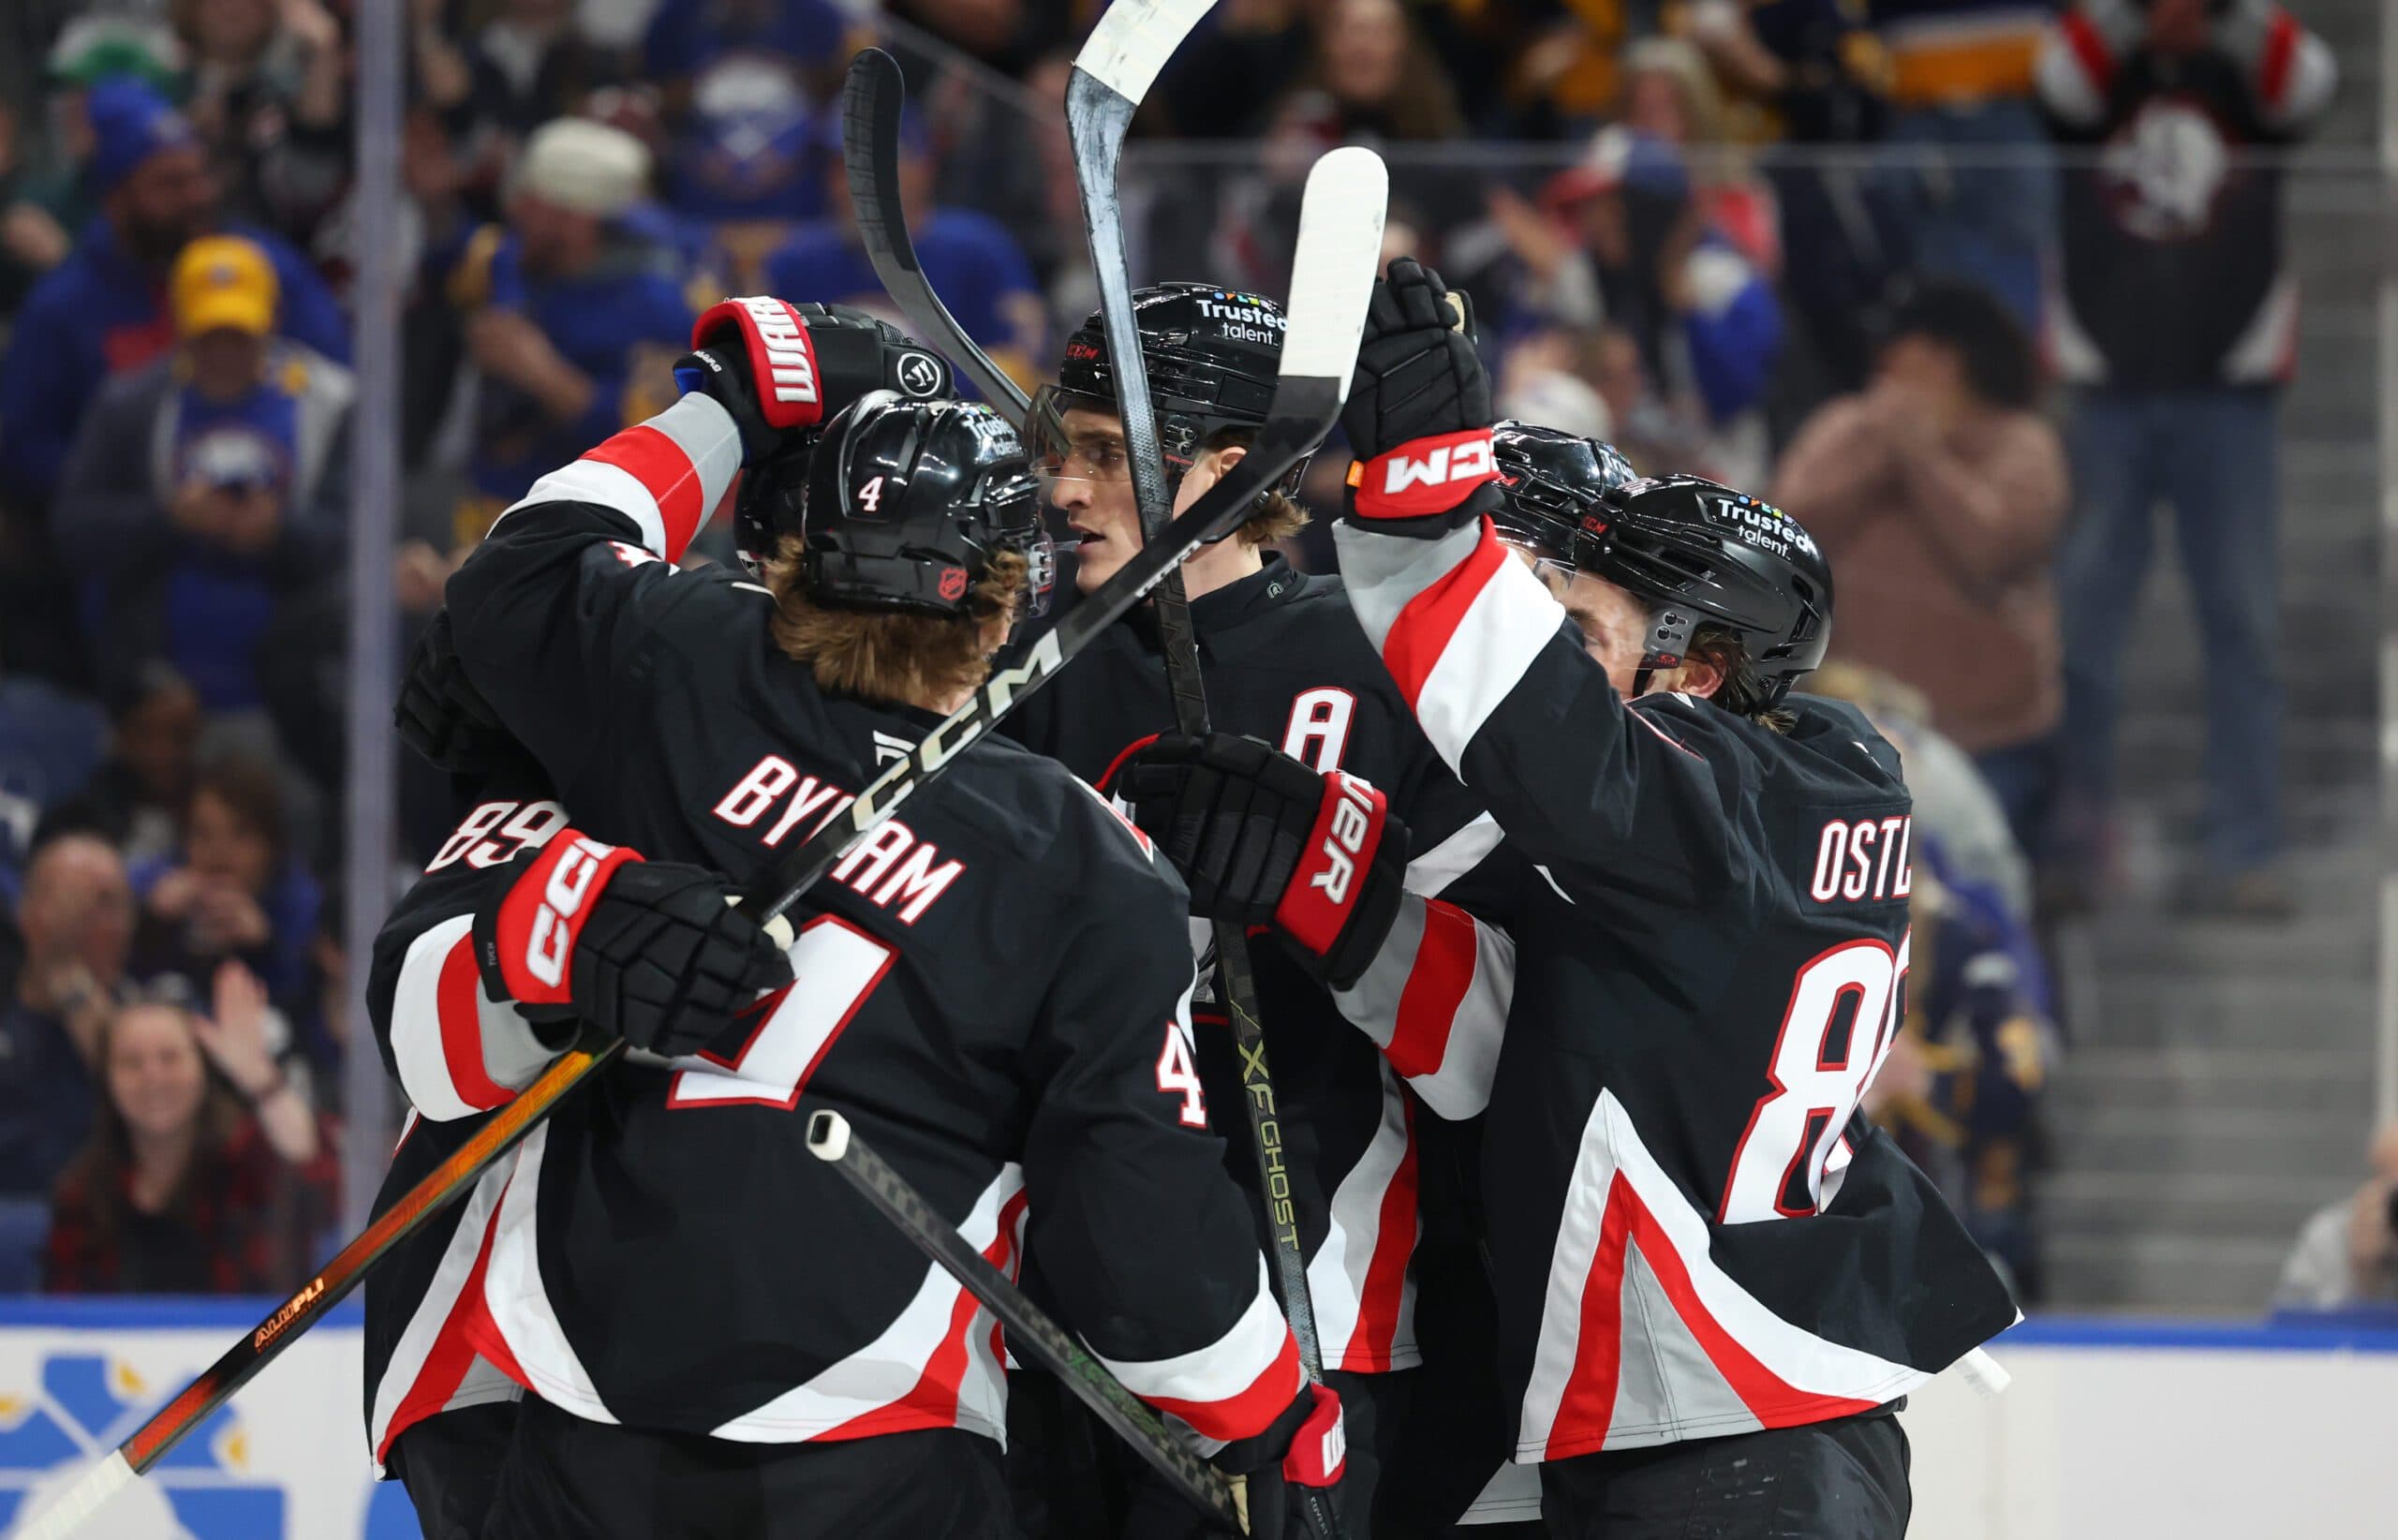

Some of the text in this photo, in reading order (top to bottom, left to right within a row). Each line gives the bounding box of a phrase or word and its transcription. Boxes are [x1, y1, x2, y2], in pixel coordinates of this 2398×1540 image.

[857, 475, 885, 512] 4
[1717, 498, 1814, 555] Trusted
[851, 626, 1063, 833] CCM
[1280, 685, 1358, 777] A
[423, 799, 570, 875] 89
[710, 753, 967, 927] BYAM
[1154, 1018, 1208, 1130] 4
[1237, 1037, 1300, 1251] XF GHOST
